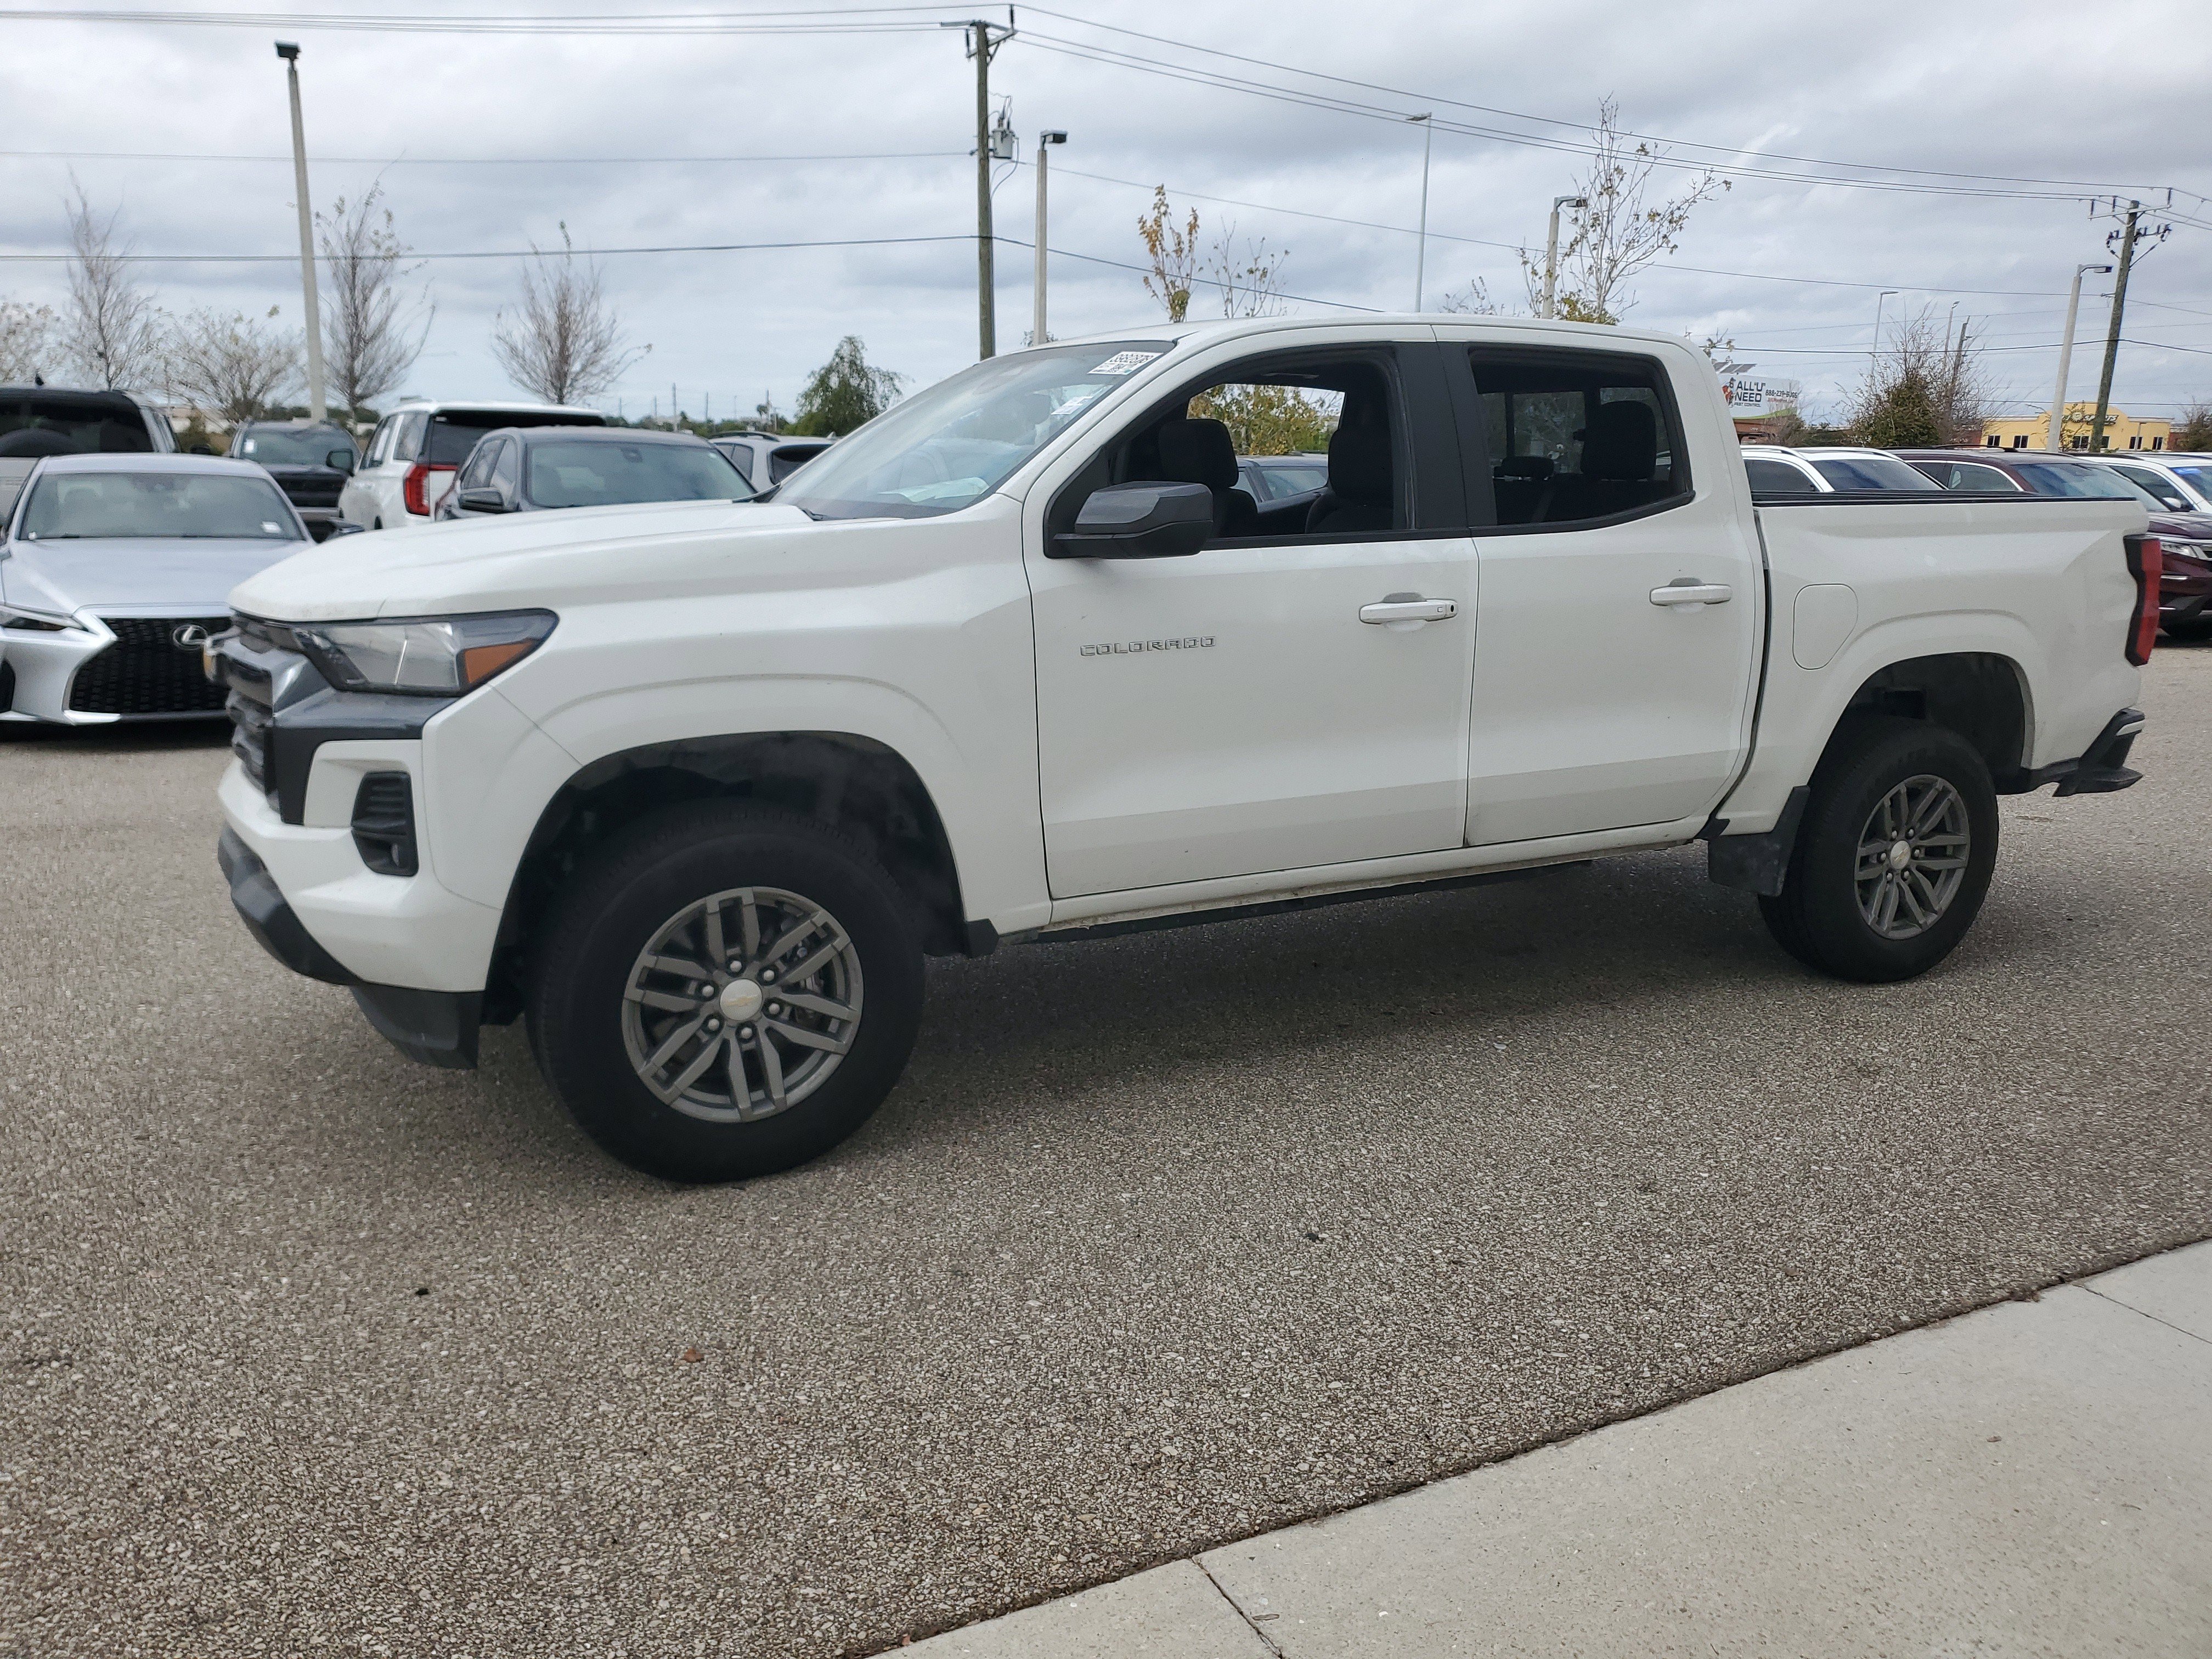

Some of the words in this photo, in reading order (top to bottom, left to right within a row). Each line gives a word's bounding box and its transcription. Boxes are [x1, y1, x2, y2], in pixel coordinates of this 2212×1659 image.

[1736, 381, 1754, 391] ALL
[1734, 392, 1762, 402] NEED
[1080, 636, 1216, 656] COLORADO
